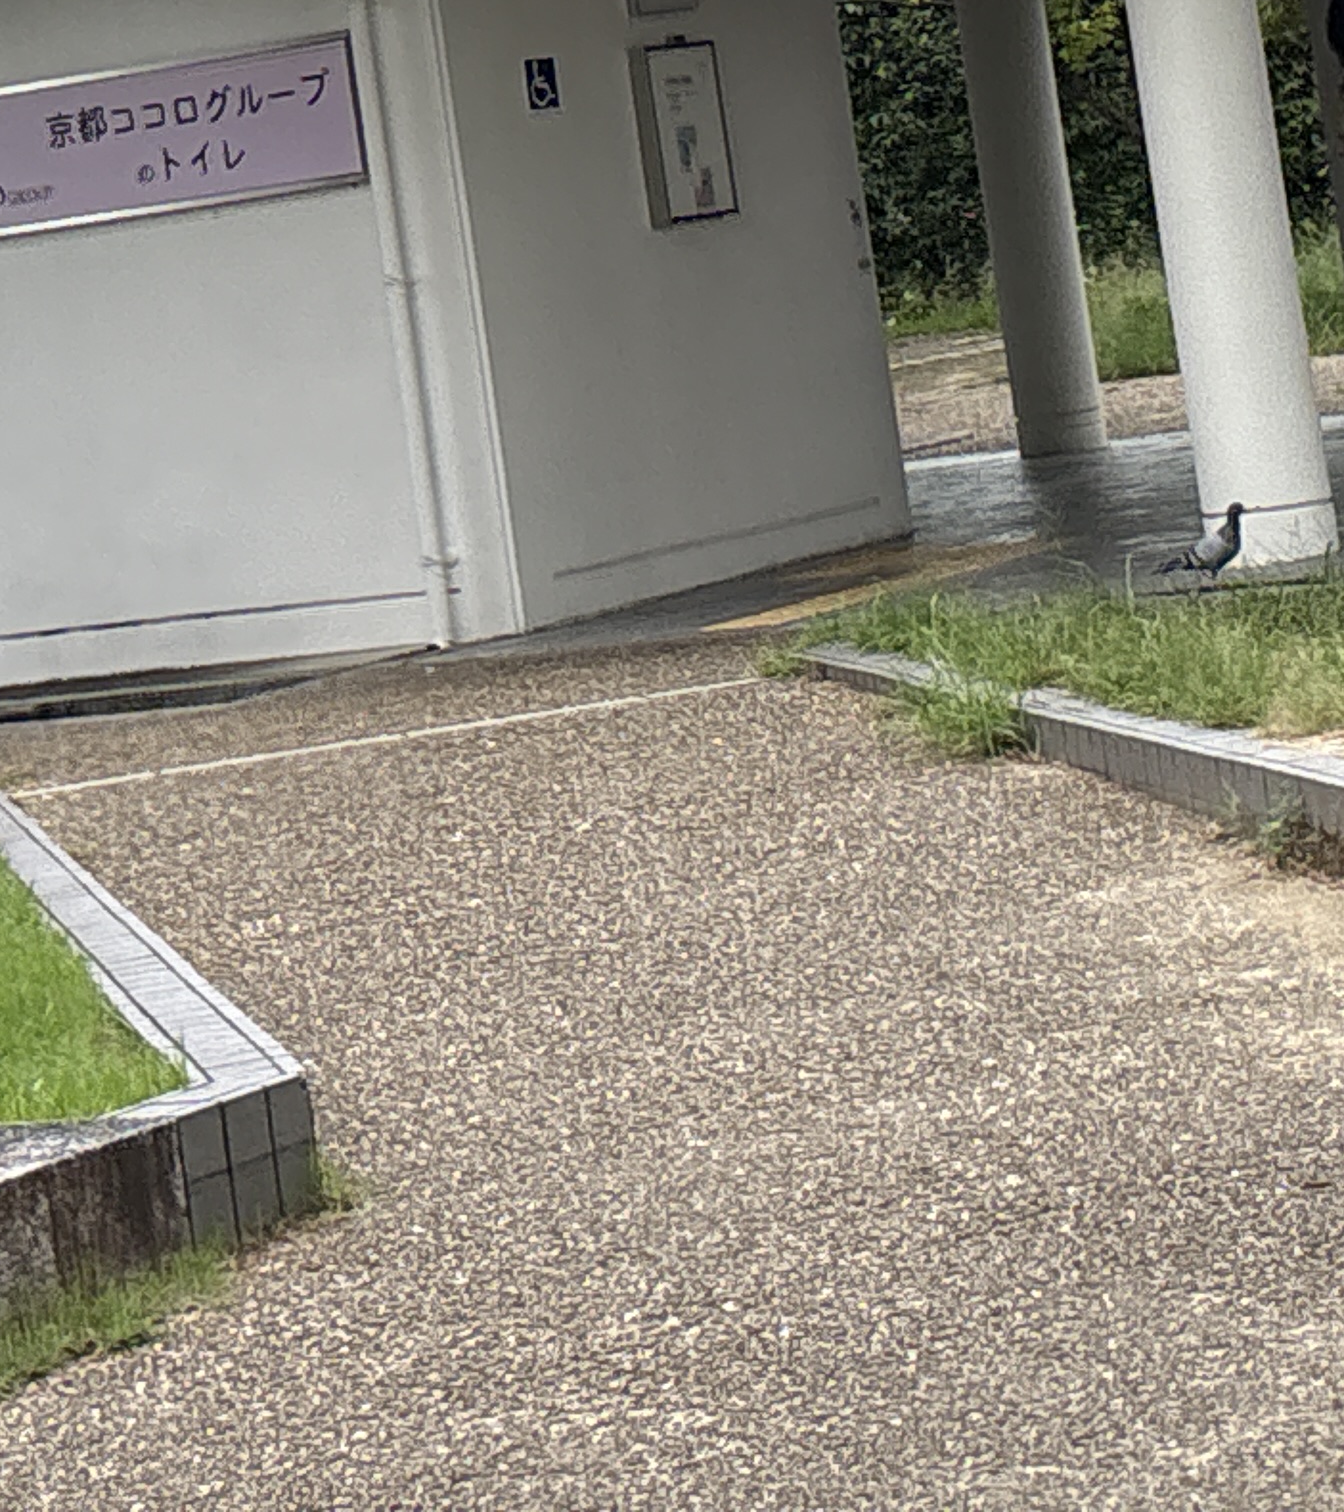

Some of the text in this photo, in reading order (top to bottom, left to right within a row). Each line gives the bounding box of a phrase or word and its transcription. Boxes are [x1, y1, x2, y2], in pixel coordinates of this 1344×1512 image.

[45, 66, 330, 149] 京都ココログループ
